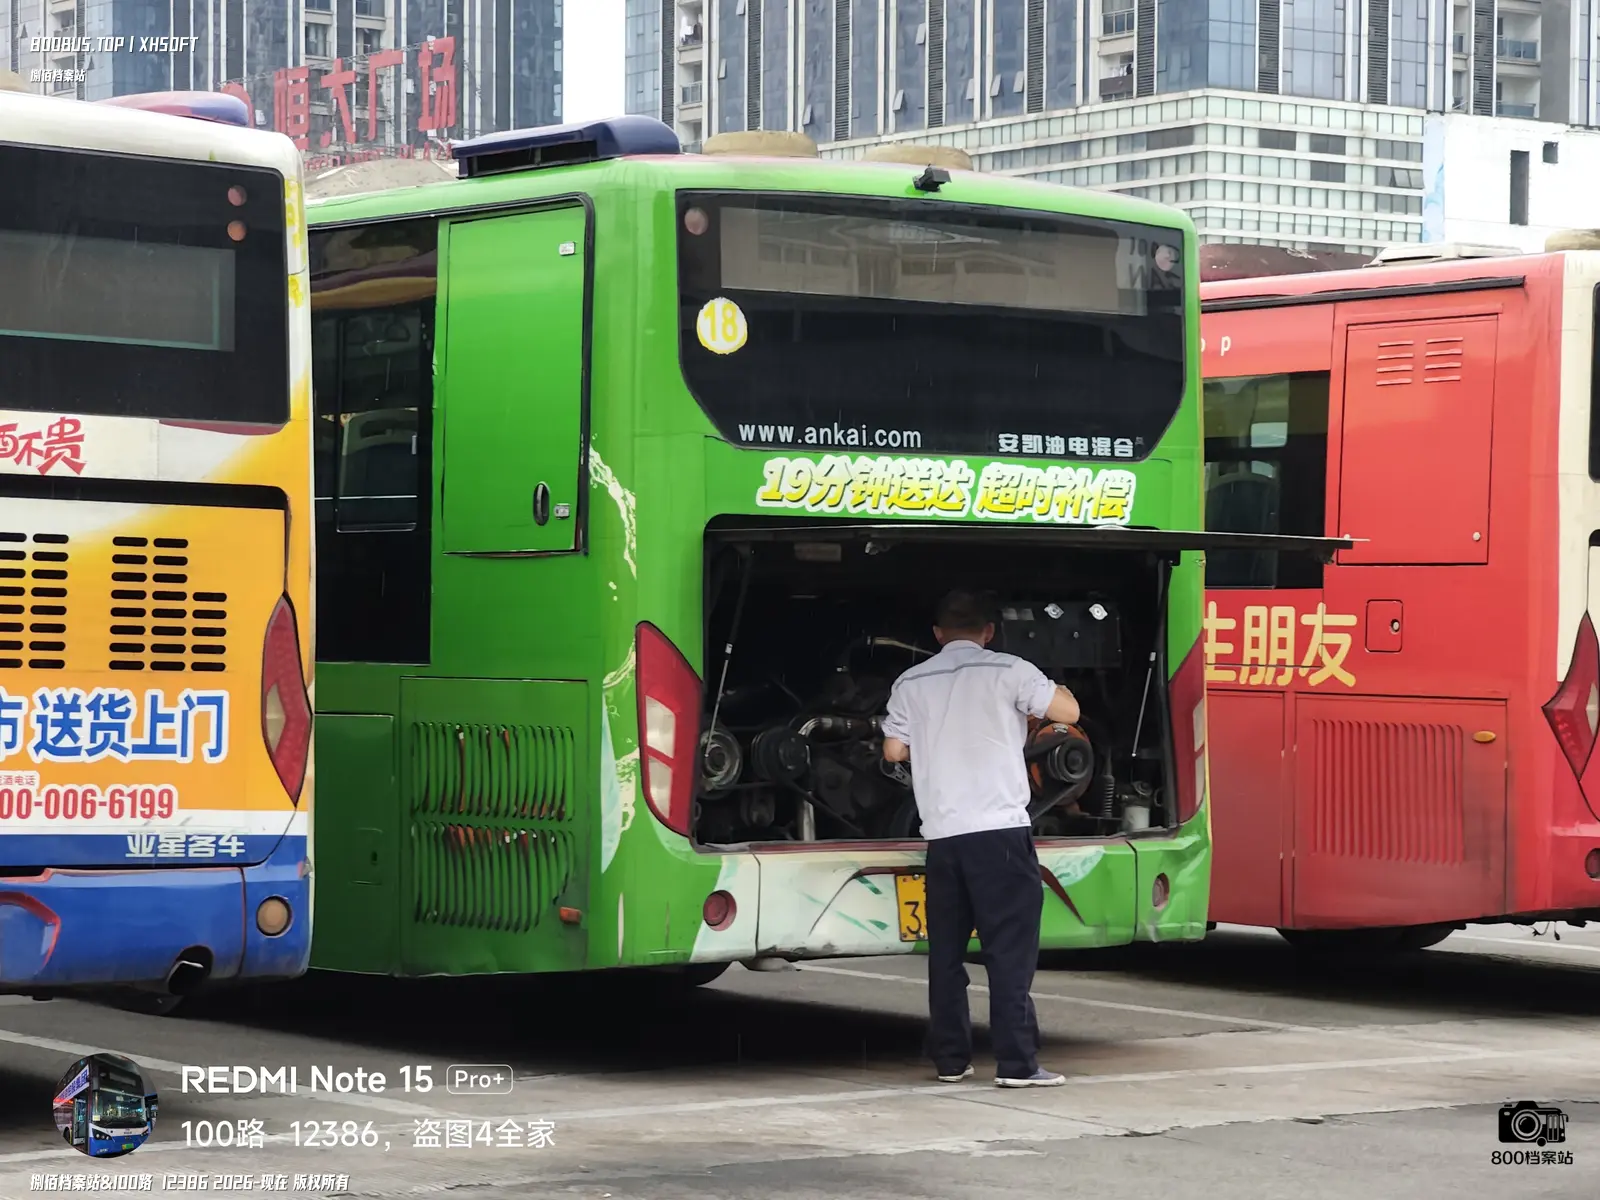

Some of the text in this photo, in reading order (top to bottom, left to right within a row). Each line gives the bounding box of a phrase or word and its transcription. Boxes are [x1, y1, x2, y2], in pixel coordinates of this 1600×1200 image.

[274, 36, 456, 150] 恒大广场
[703, 302, 738, 343] 18
[738, 422, 922, 448] www.ankai.com
[998, 433, 1134, 457] 安凯油电混合
[759, 458, 1134, 520] 19分钟送达 超时补偿
[125, 830, 246, 858] 亚星客车
